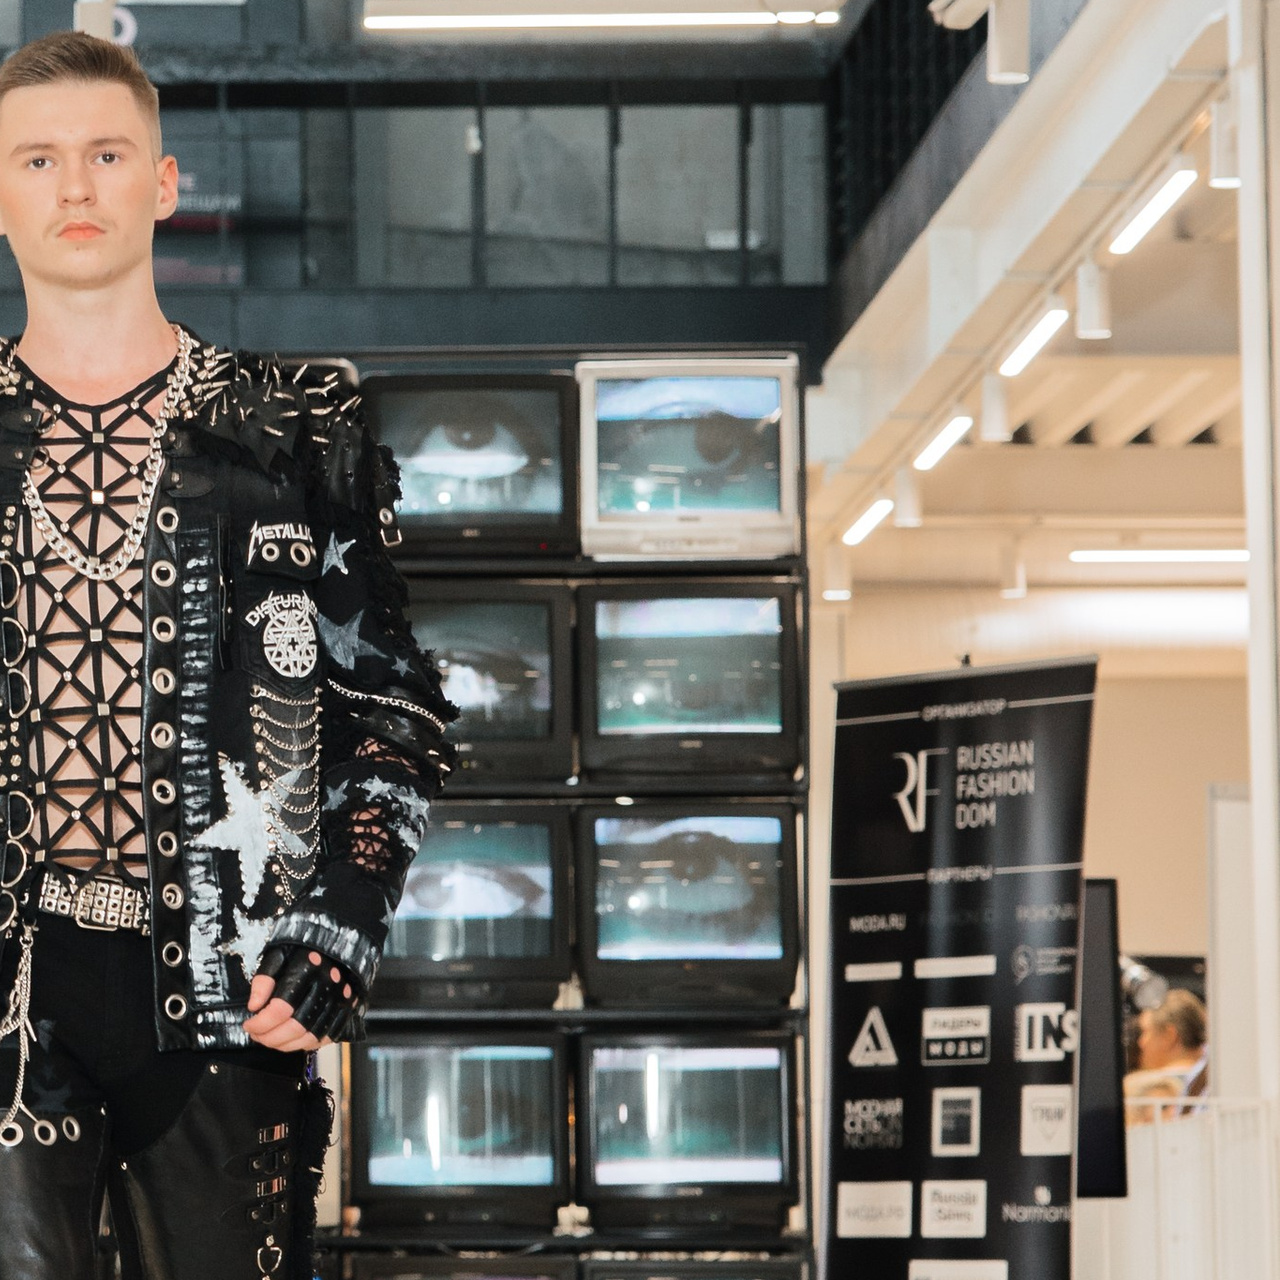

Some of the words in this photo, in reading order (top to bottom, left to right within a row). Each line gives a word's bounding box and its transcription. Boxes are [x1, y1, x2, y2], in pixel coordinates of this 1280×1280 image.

[956, 740, 1035, 770] RUSSIAN
[956, 769, 1035, 800] FASHION
[955, 801, 997, 829] DOM
